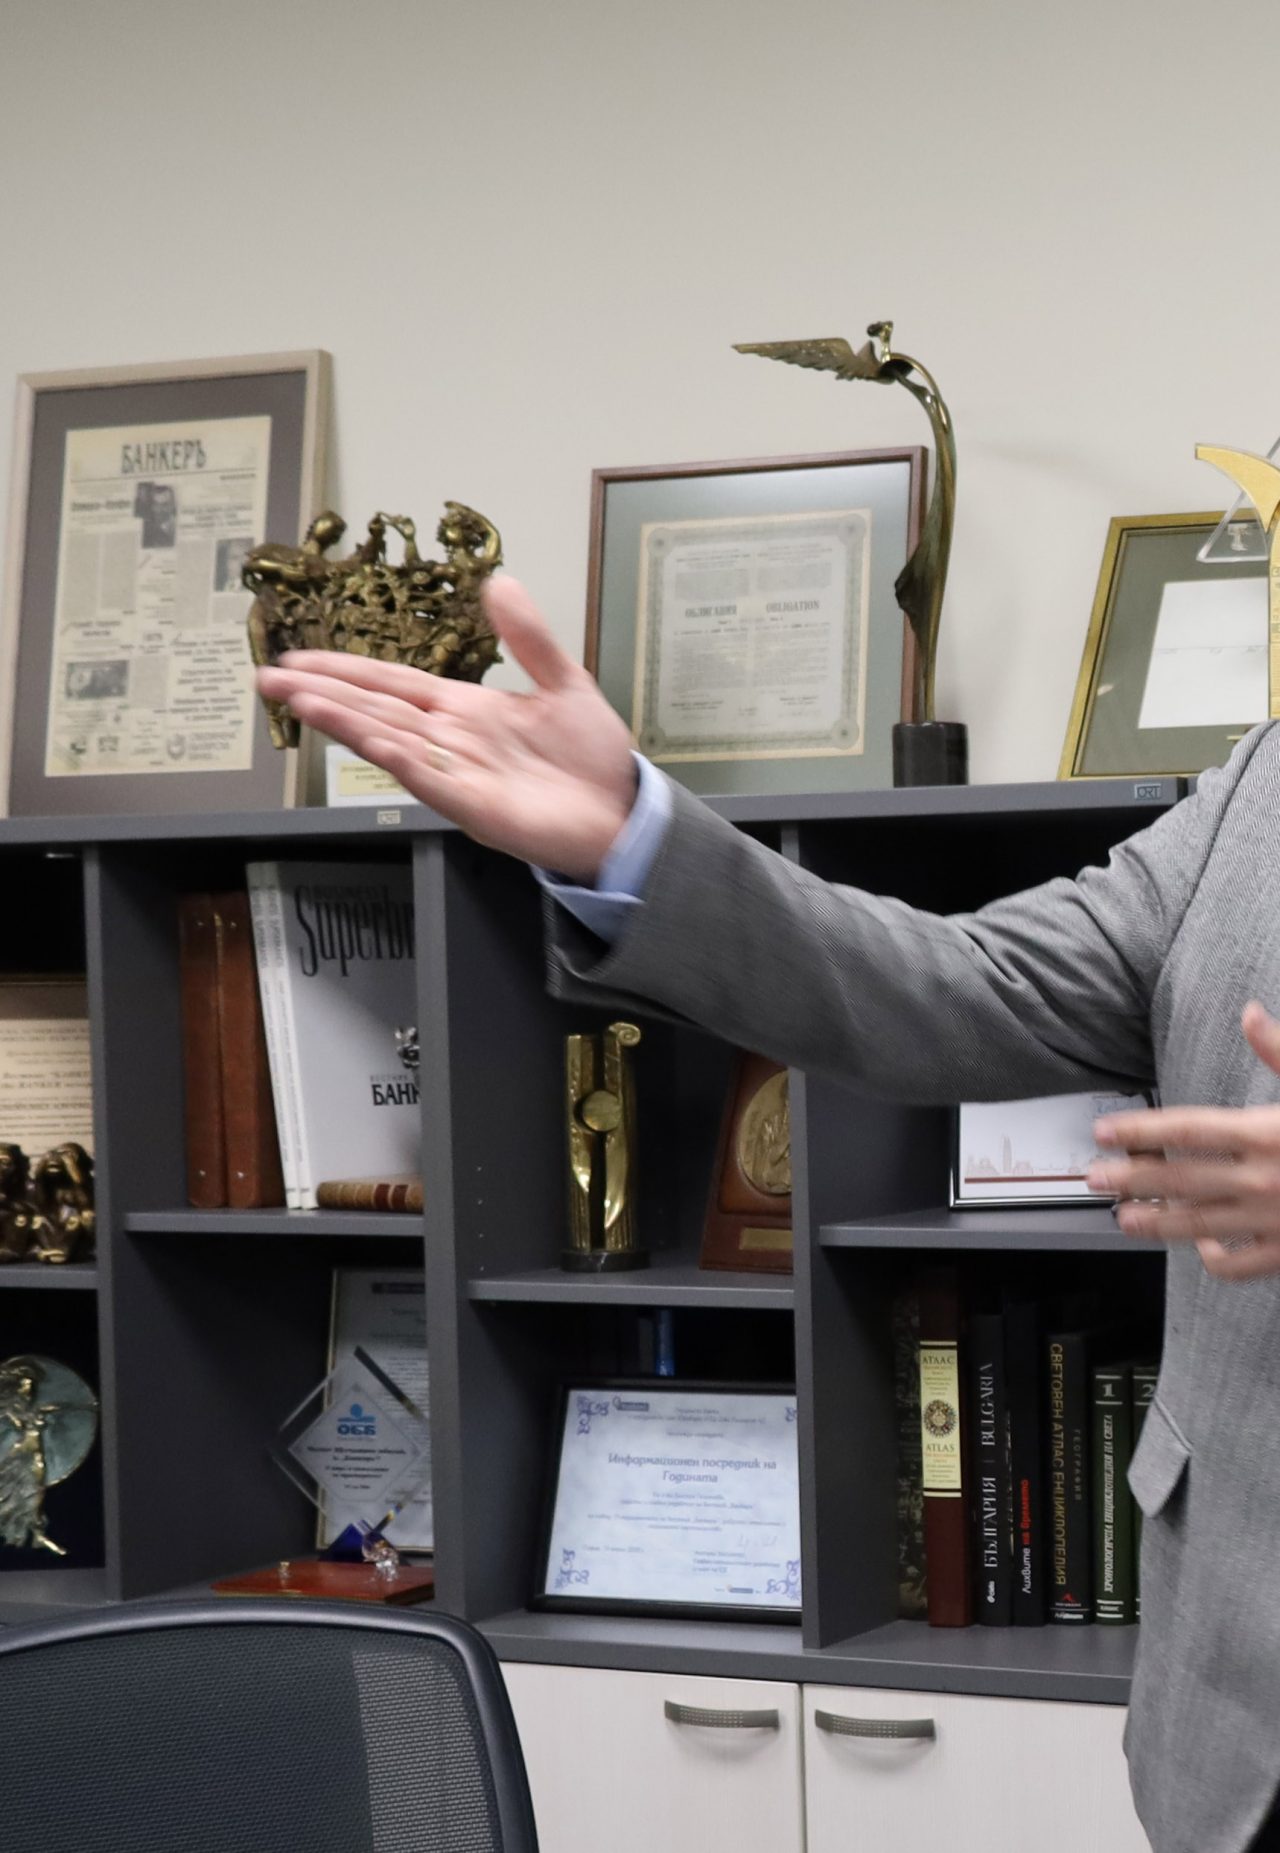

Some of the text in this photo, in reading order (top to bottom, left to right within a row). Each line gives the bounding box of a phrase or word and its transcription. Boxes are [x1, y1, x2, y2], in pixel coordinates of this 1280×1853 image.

[121, 439, 207, 473] БАНКЕРЪ
[1102, 1383, 1116, 1398] 1
[1141, 1383, 1156, 1398] 2
[979, 1362, 996, 1447] BULGARIA
[608, 1452, 700, 1469] Информационен
[702, 1456, 762, 1471] посредник
[1050, 1343, 1067, 1586] СВЕТОВЕН АТЛАС ЕНЦИКЛОПЕДИЯ
[662, 1471, 718, 1484] Годината
[981, 1477, 998, 1568] БЪЛГАРИЯ
